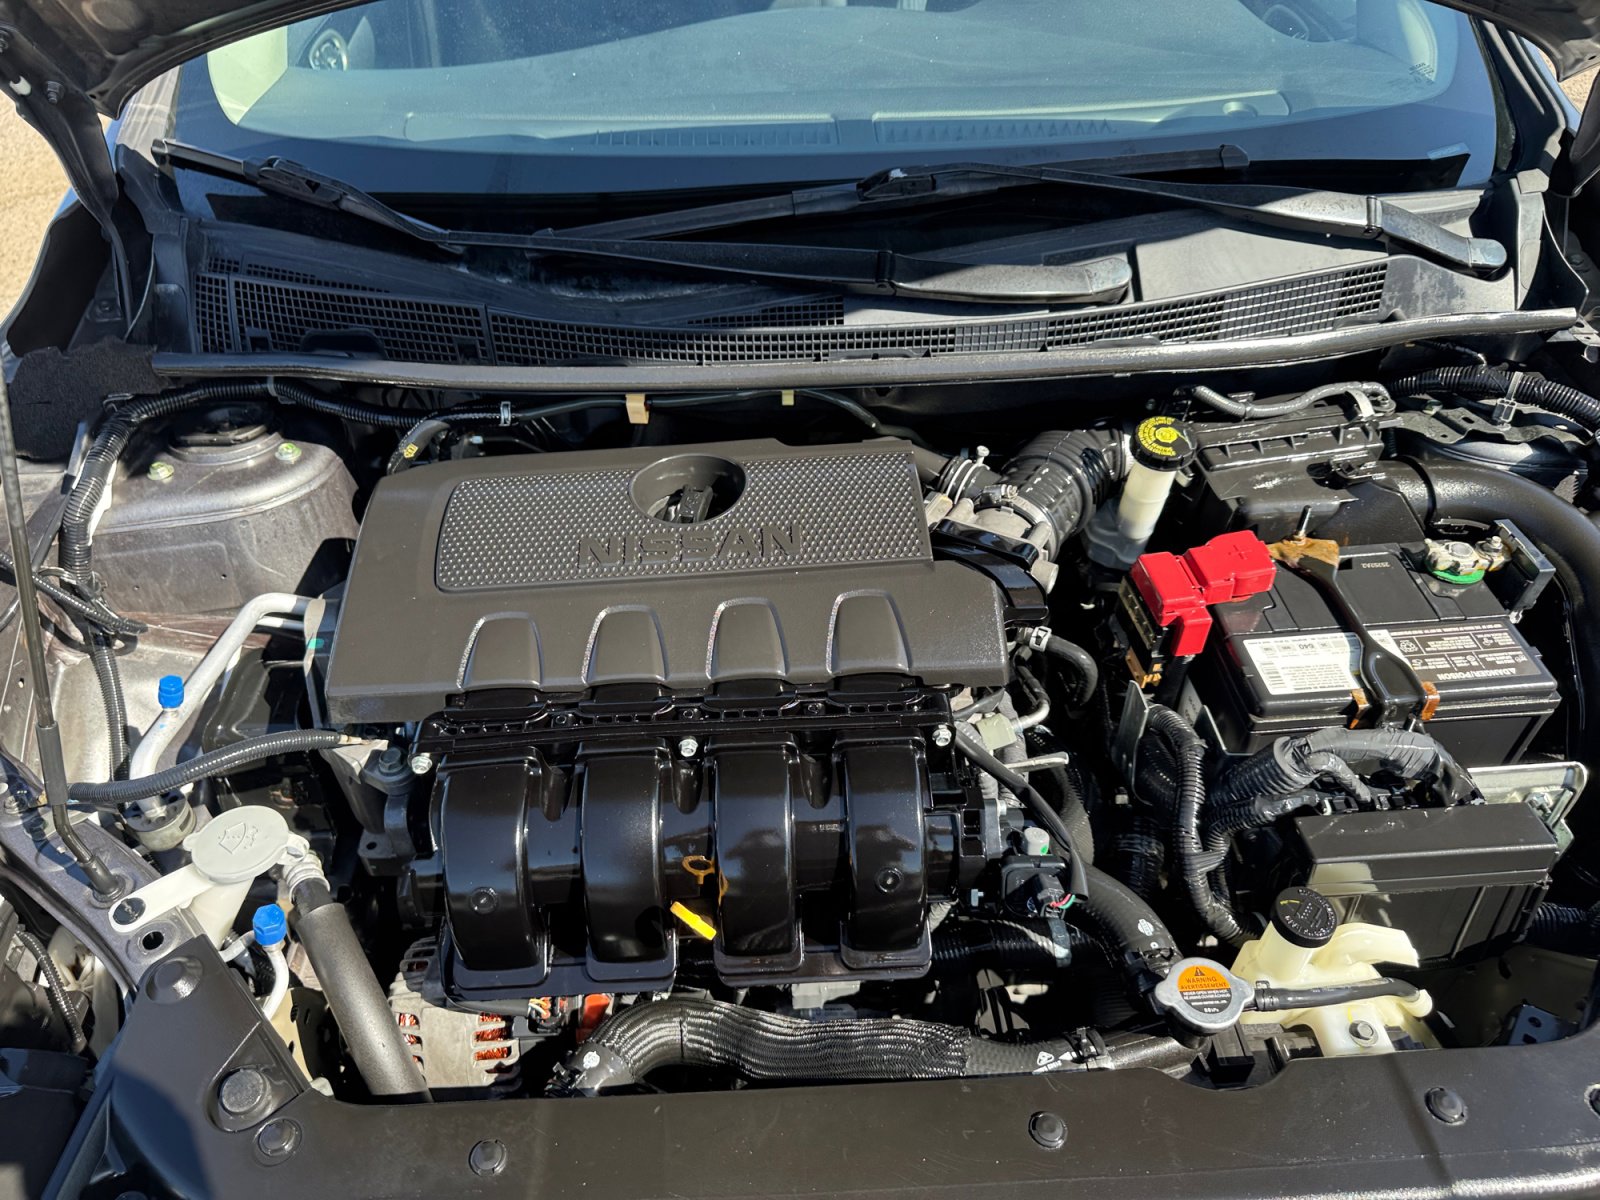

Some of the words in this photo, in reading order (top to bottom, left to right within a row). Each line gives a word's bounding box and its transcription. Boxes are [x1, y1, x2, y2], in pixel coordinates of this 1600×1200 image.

[577, 525, 803, 569] NISSAN
[1437, 669, 1509, 680] DANGER/POISON
[1181, 982, 1227, 990] AVERTISSEMENT
